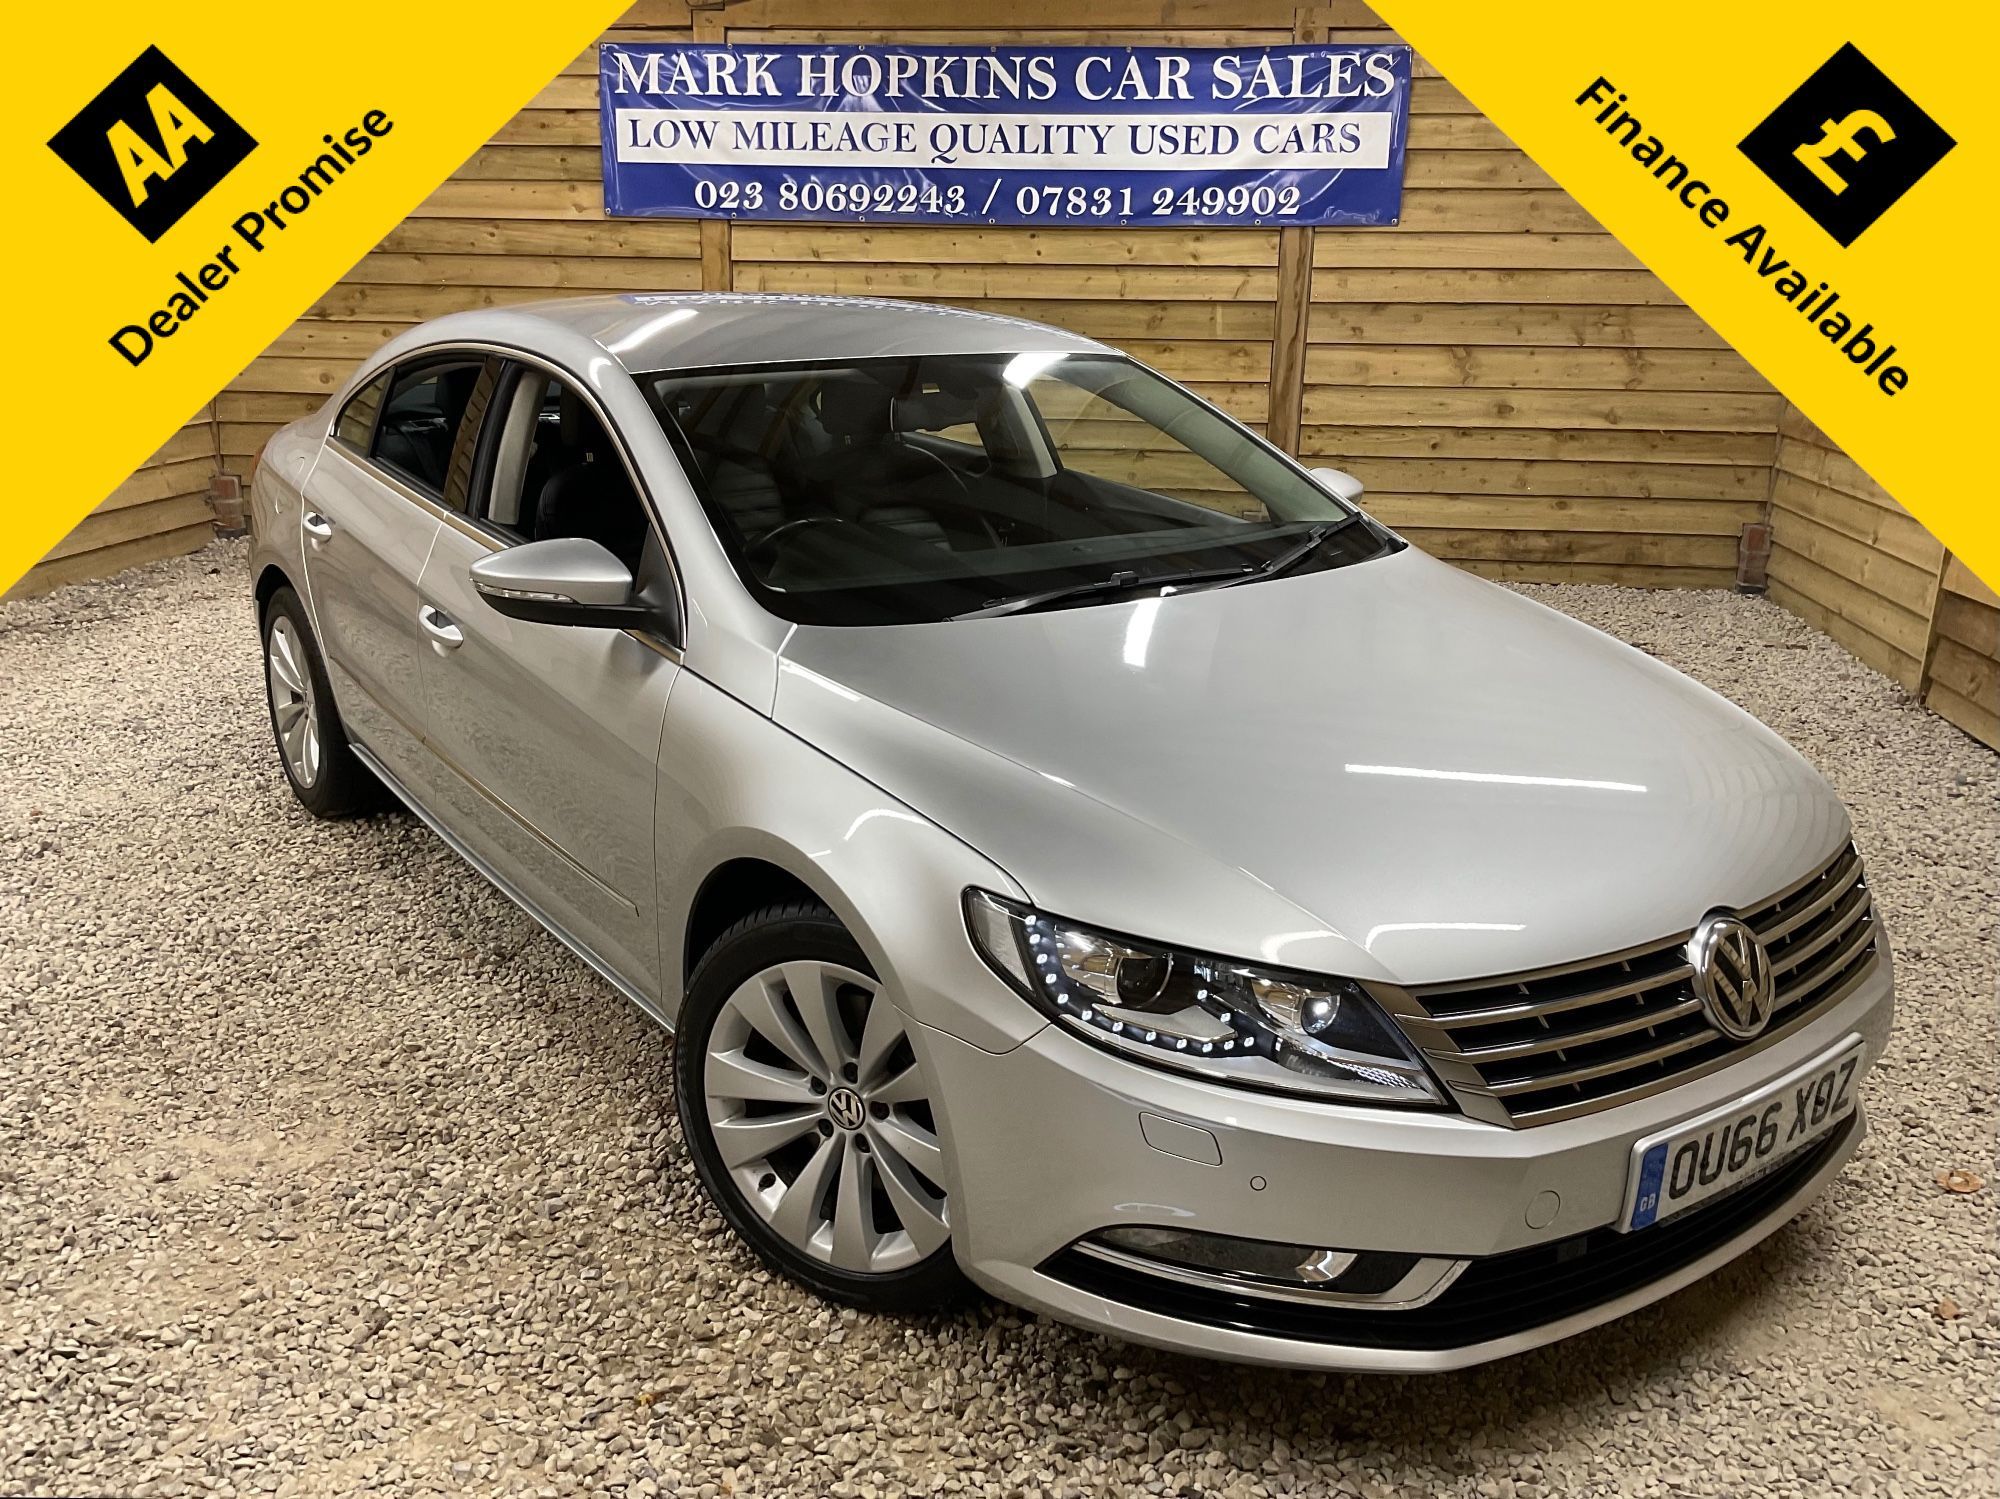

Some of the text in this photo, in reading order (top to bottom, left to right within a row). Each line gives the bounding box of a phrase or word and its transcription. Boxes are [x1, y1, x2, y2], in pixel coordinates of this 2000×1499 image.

[614, 52, 1395, 101] MARK HOPKINS CAR SALES
[628, 118, 1361, 164] LOW MILEAGE QUALITY USED CARS
[694, 180, 764, 210] 023
[779, 182, 965, 214] 80692243
[1016, 186, 1134, 216] 07831
[1152, 186, 1300, 216] 249902
[1668, 1102, 1782, 1199] OU66
[1640, 1193, 1656, 1211] GB
